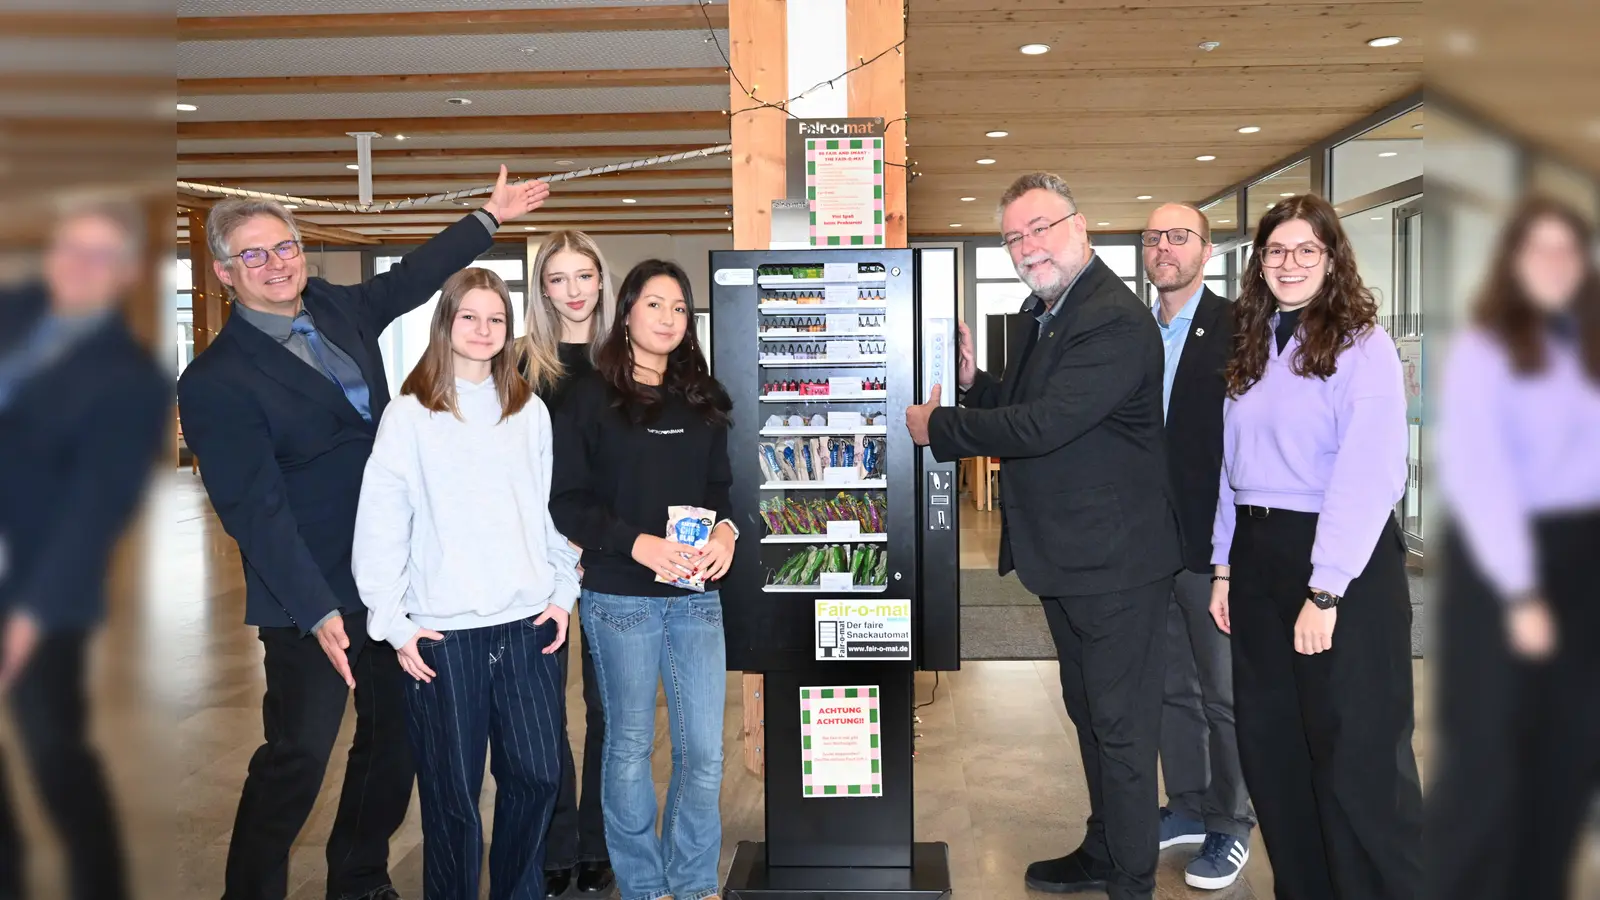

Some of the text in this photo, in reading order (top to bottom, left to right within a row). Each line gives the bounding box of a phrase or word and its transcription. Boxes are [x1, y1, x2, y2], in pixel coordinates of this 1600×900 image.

[799, 121, 874, 135] Fair-o-mat
[817, 602, 909, 617] Fair-o-mat
[846, 621, 884, 629] Der faire
[846, 631, 909, 639] Snackautomat
[816, 717, 865, 725] ACHTUNG!!
